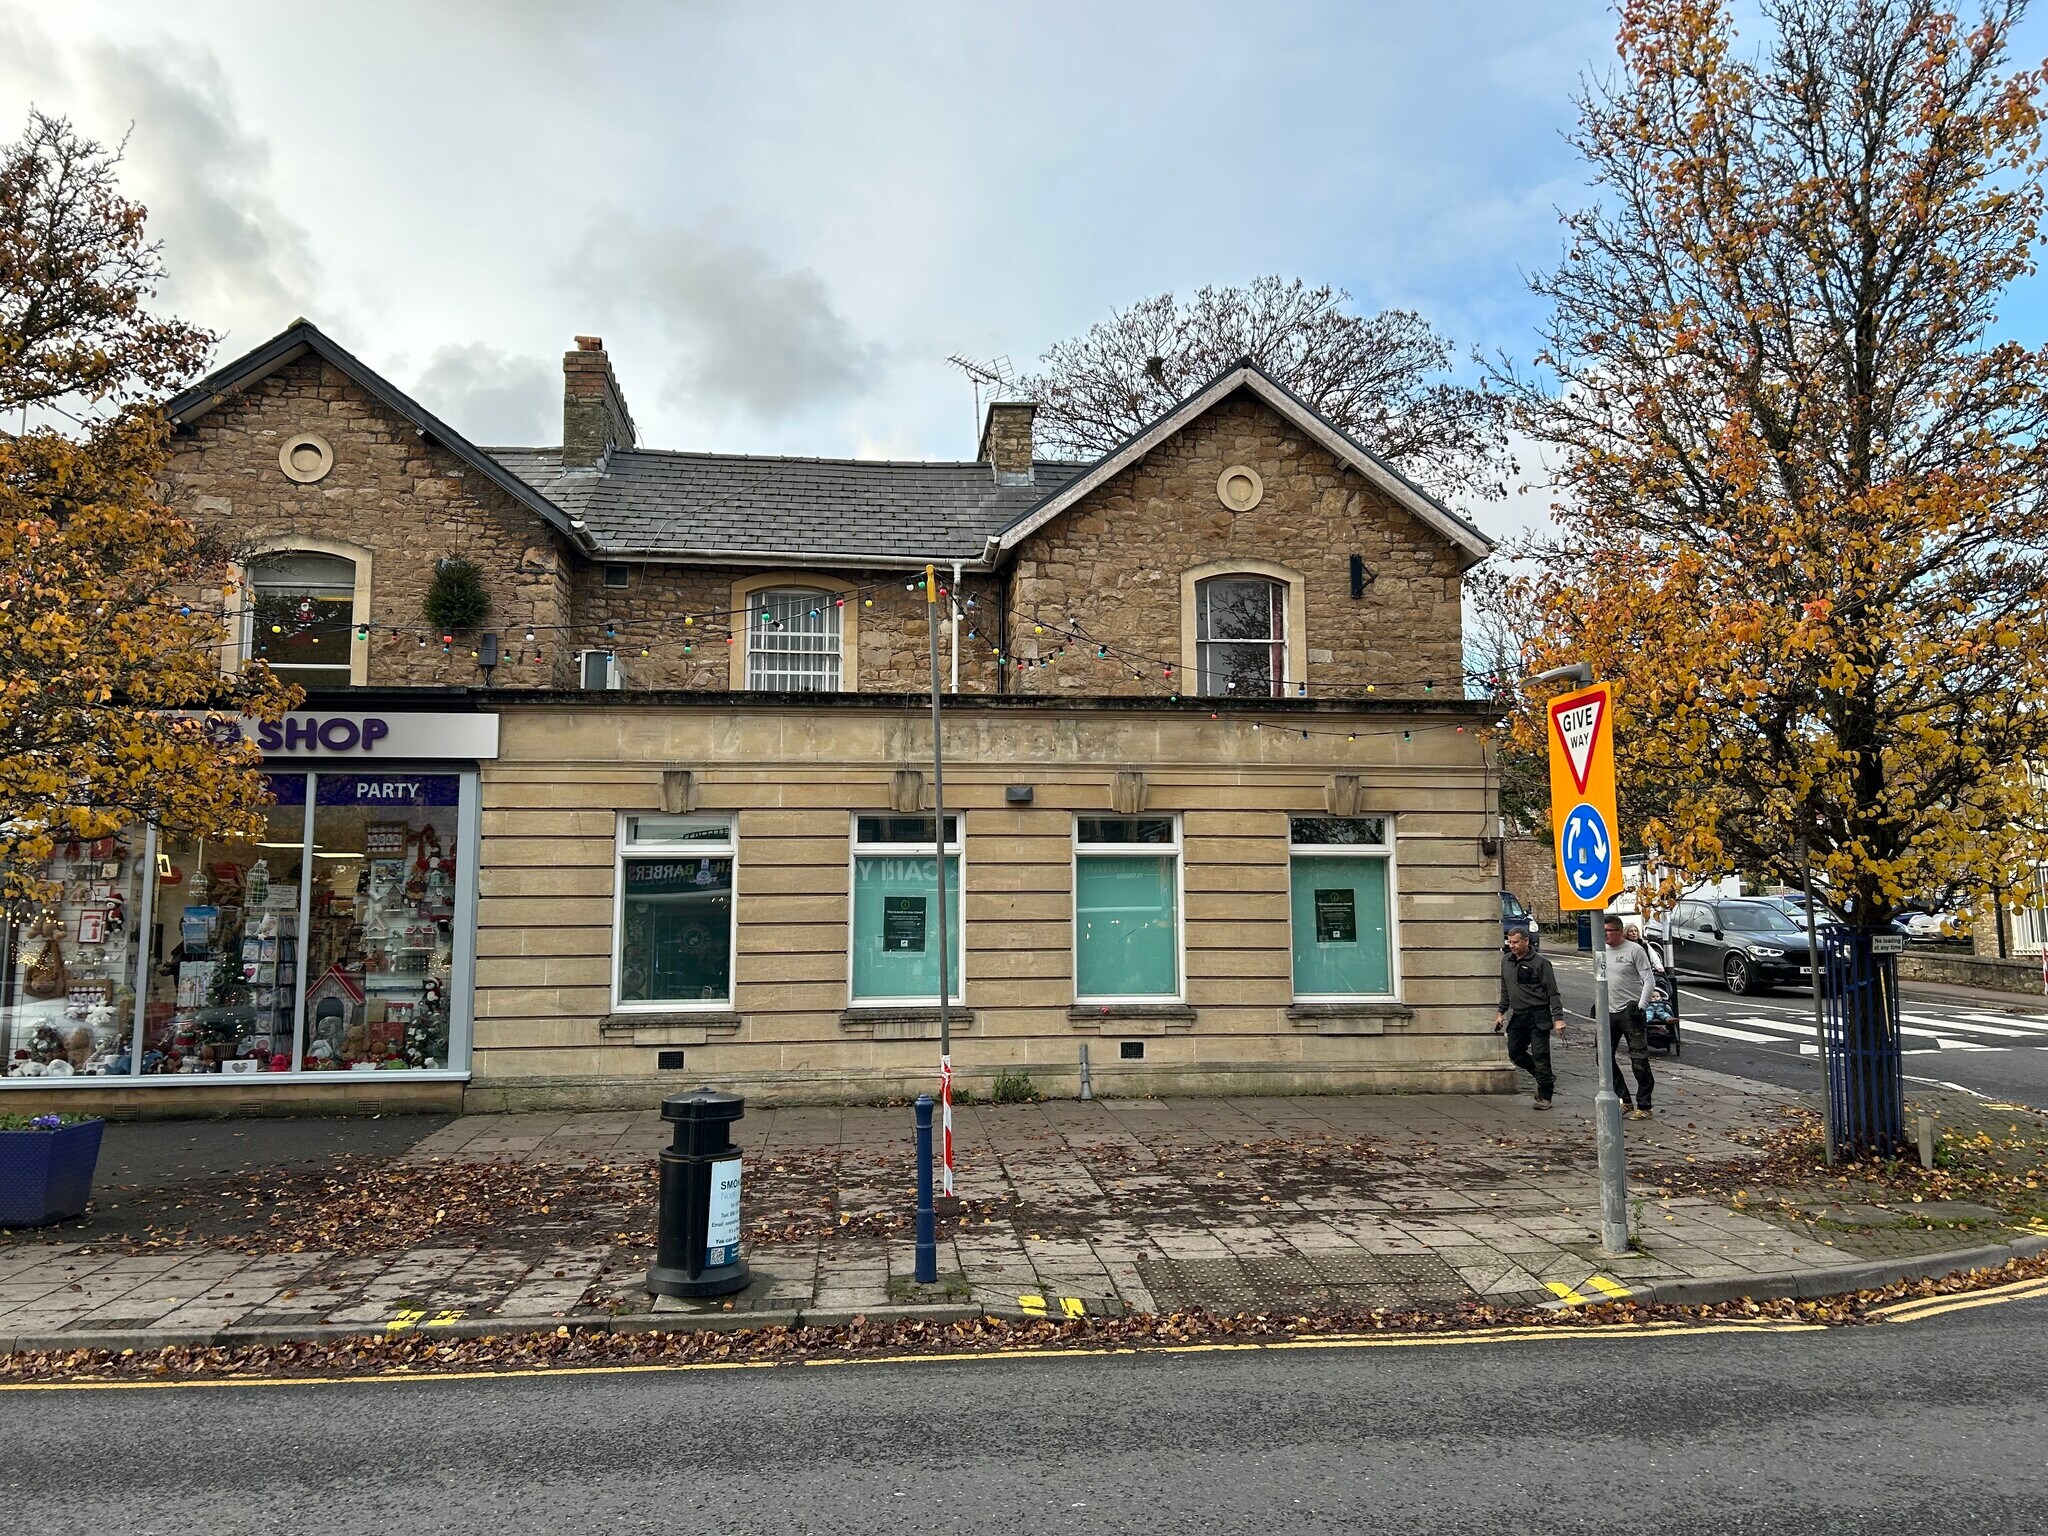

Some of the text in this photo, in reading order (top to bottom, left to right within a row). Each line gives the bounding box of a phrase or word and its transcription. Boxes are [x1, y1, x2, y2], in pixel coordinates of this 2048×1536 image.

[1563, 707, 1592, 732] GIVE
[257, 717, 388, 750] SHOP
[1570, 732, 1589, 749] WAY
[356, 783, 419, 798] PARTY
